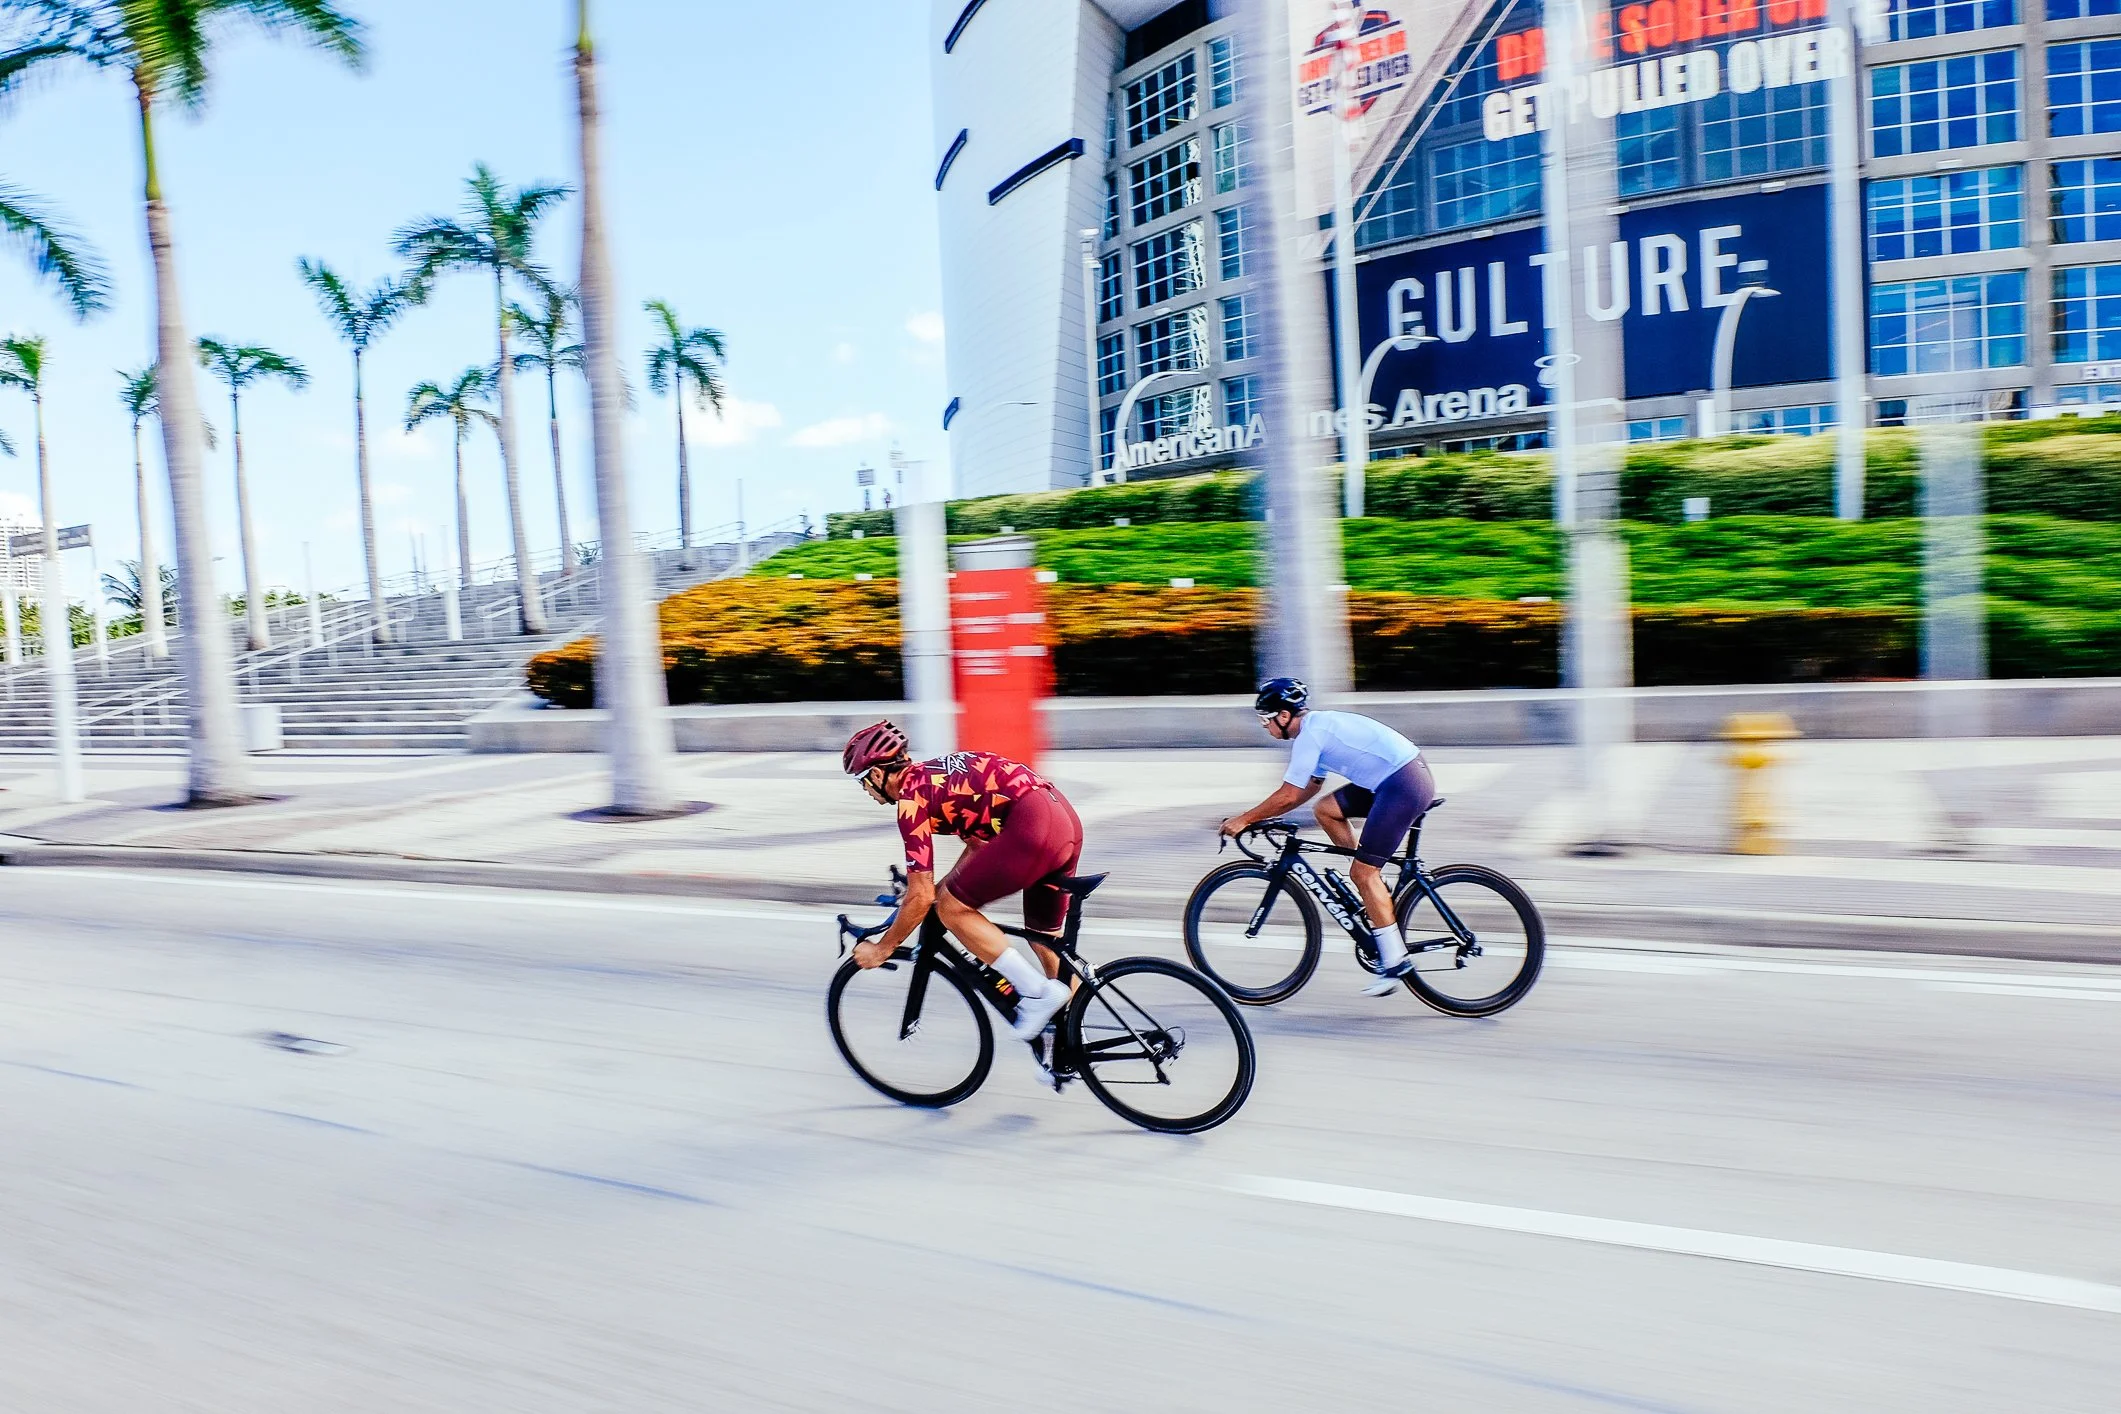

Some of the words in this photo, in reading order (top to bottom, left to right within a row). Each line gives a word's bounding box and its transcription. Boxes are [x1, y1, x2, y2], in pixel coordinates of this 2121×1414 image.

[1483, 81, 1556, 141] GET
[1727, 27, 1849, 94] OVER
[1387, 224, 1743, 351] CULTURE
[1391, 383, 1529, 427] Arena
[1291, 862, 1355, 930] cervélo
